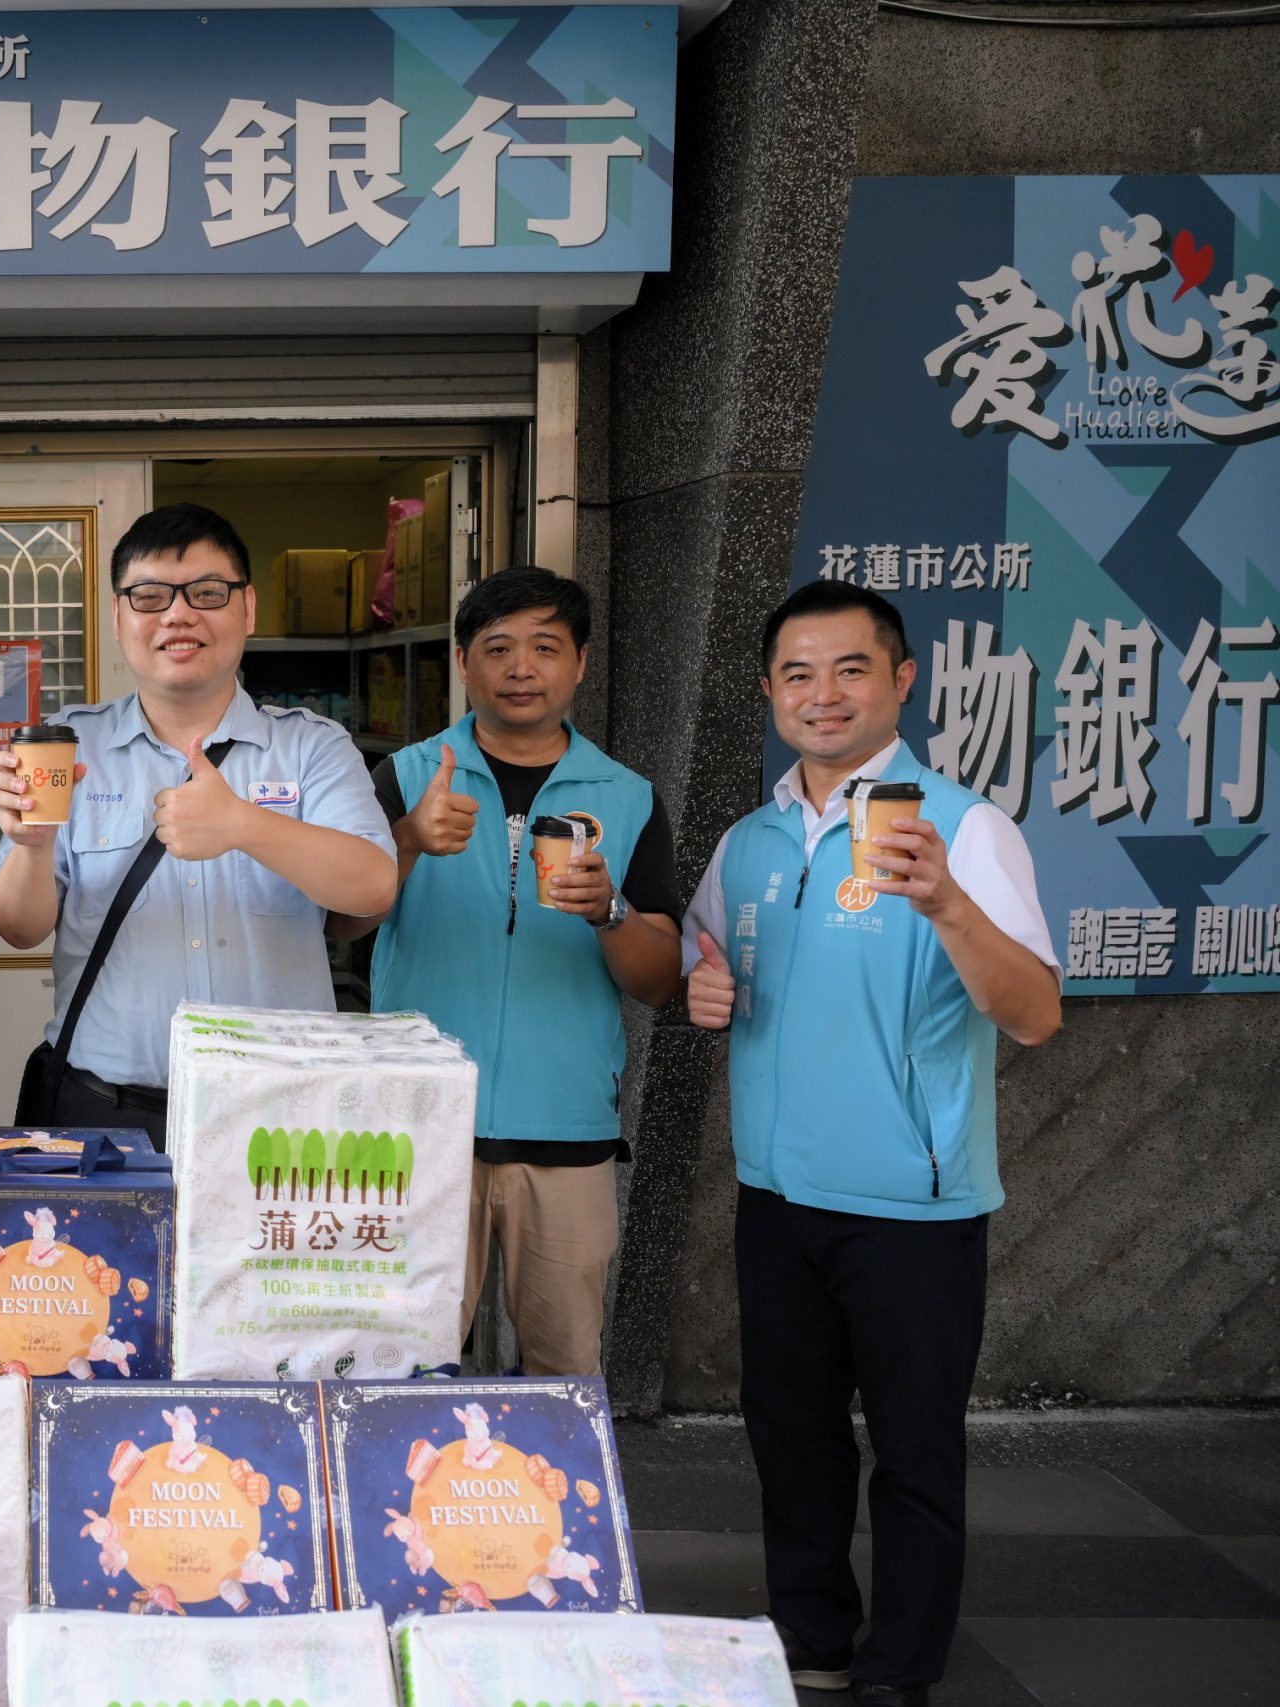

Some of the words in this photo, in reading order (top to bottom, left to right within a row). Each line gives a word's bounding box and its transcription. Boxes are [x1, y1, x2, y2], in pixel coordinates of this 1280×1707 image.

[1088, 366, 1157, 396] Love
[1065, 402, 1178, 429] Hualien
[818, 542, 1033, 591] 花蓮市公所
[51, 775, 67, 786] GO
[259, 784, 289, 797] 中油
[256, 1166, 410, 1205] DANDELION
[248, 1210, 398, 1252] 蒲公英
[241, 1258, 407, 1275] 不砍樹環保抽取式衛生紙
[11, 1275, 76, 1293] MOON
[261, 1279, 386, 1299] 100%再生紙製造
[151, 1482, 222, 1501] MOON
[450, 1479, 520, 1498] MOON
[128, 1509, 244, 1528] FESTIVAL
[429, 1505, 544, 1526] FESTIVAL
